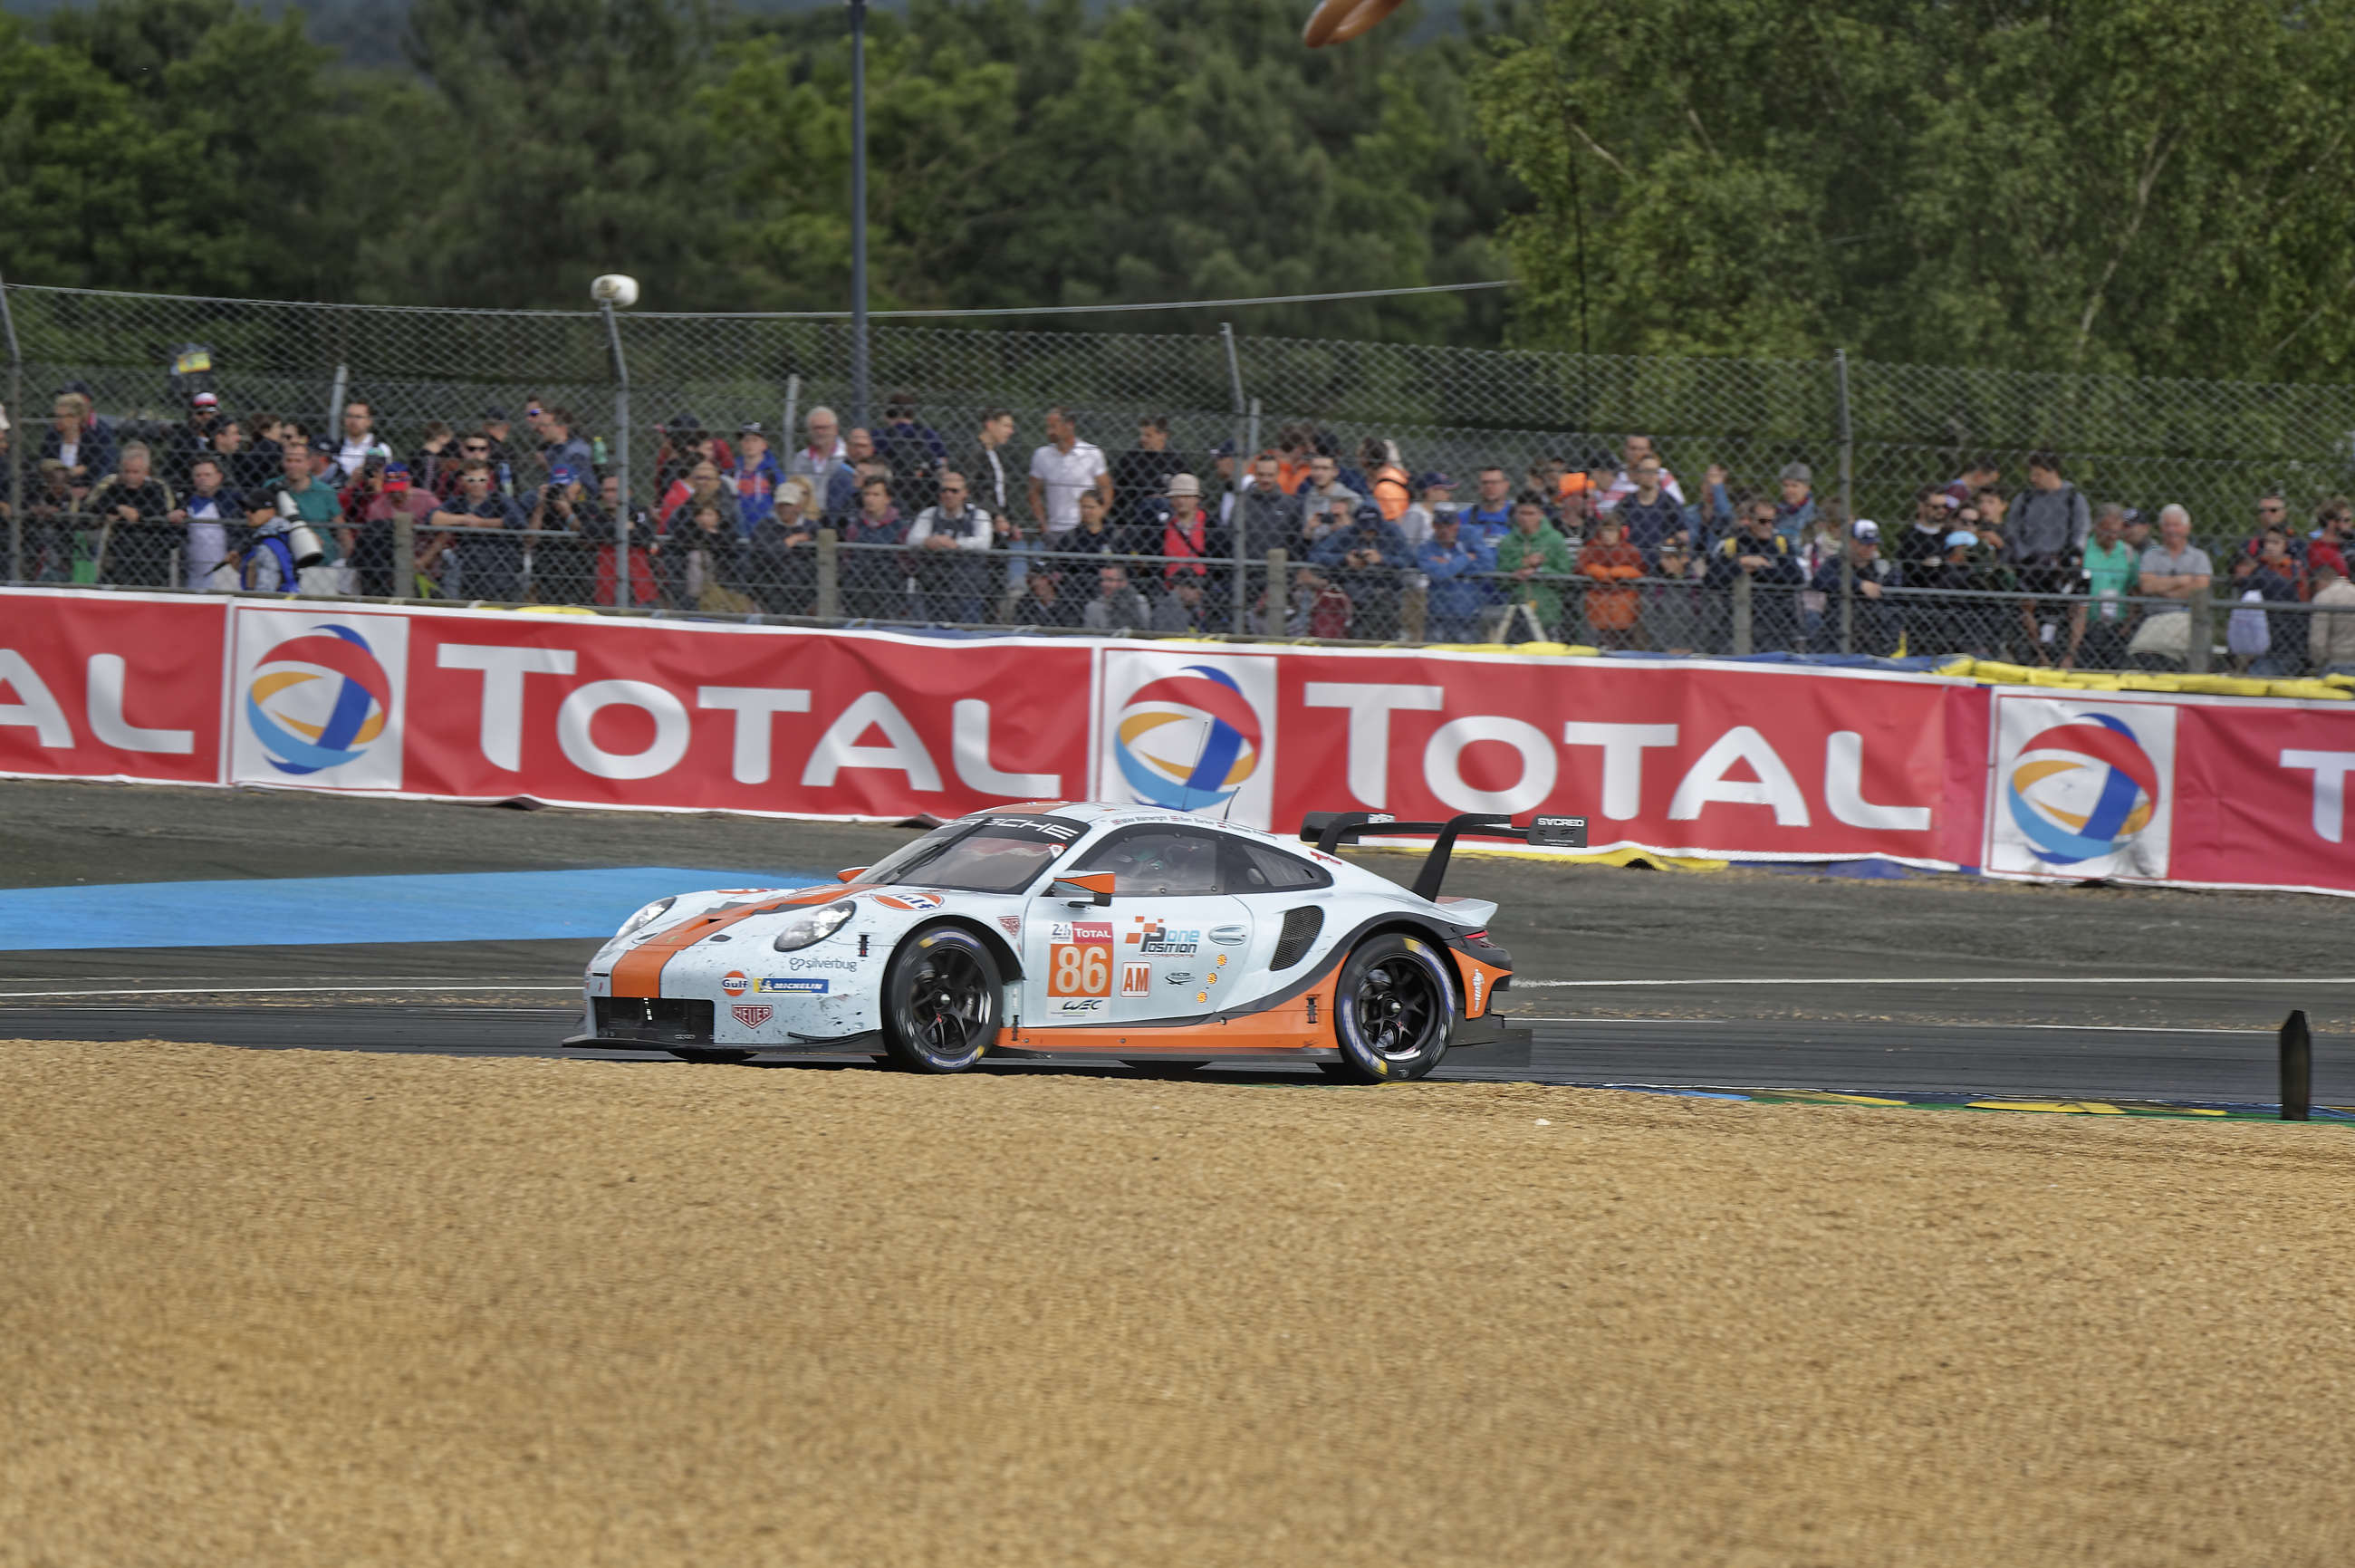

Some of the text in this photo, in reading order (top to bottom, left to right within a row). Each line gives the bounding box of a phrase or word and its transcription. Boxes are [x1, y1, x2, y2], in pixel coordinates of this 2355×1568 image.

[436, 642, 1061, 799] TOTAL
[1304, 681, 1931, 831] TOTAL
[1073, 928, 1111, 938] TOTAL
[1167, 929, 1201, 943] one
[805, 957, 857, 973] silverbug
[1055, 946, 1108, 994] 86
[722, 978, 749, 988] Gulf
[774, 982, 823, 990] MICHELIN
[1123, 967, 1149, 992] AM
[1062, 999, 1102, 1011] WEC
[735, 1006, 771, 1026] HEUER
